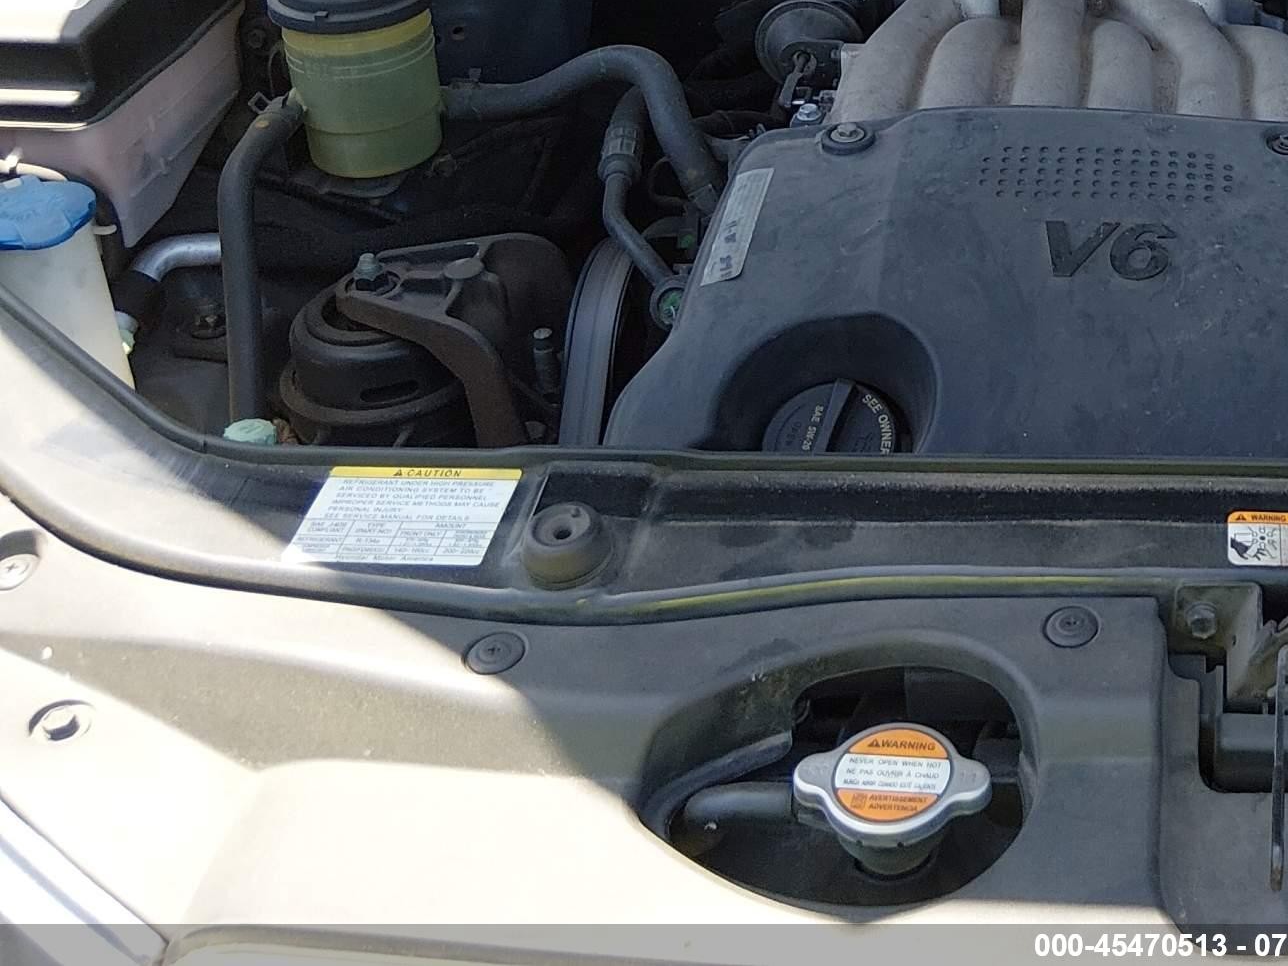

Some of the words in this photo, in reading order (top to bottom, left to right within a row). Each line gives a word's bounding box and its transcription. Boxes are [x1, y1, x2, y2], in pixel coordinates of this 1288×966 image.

[1046, 220, 1177, 281] V6
[862, 393, 883, 414] SEE
[811, 404, 825, 423] SAE
[407, 469, 462, 478] CAUTION
[880, 737, 936, 752] WARNING
[849, 757, 874, 765] NEVER
[869, 794, 929, 803] AVERTISSEMENT
[868, 803, 919, 812] ADVERTENCIA
